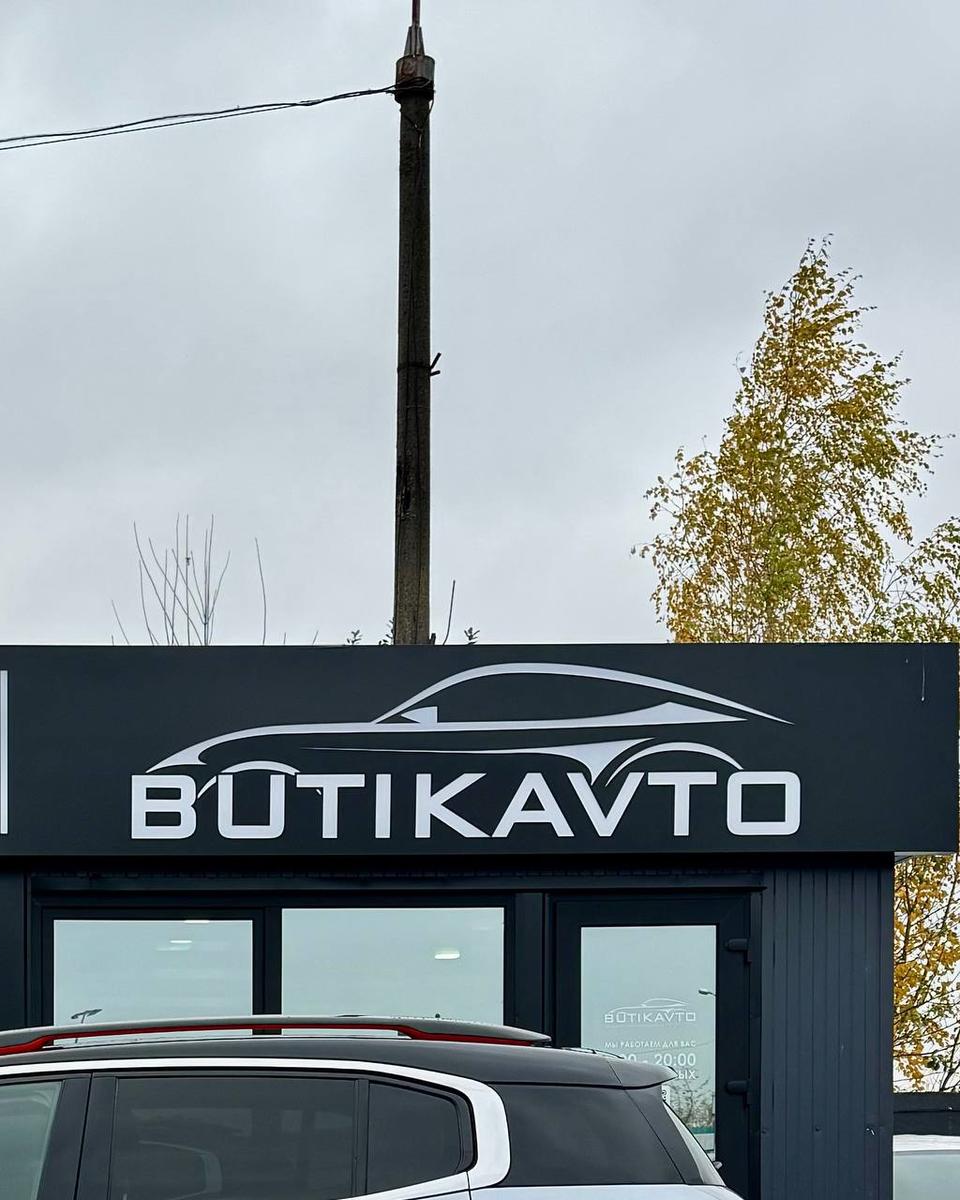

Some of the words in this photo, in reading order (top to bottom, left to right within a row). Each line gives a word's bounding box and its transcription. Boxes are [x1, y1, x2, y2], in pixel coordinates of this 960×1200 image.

[131, 771, 801, 839] BUTIKAVTO
[604, 1012, 697, 1023] BUTIKAVTO
[654, 1053, 697, 1066] 20:00
